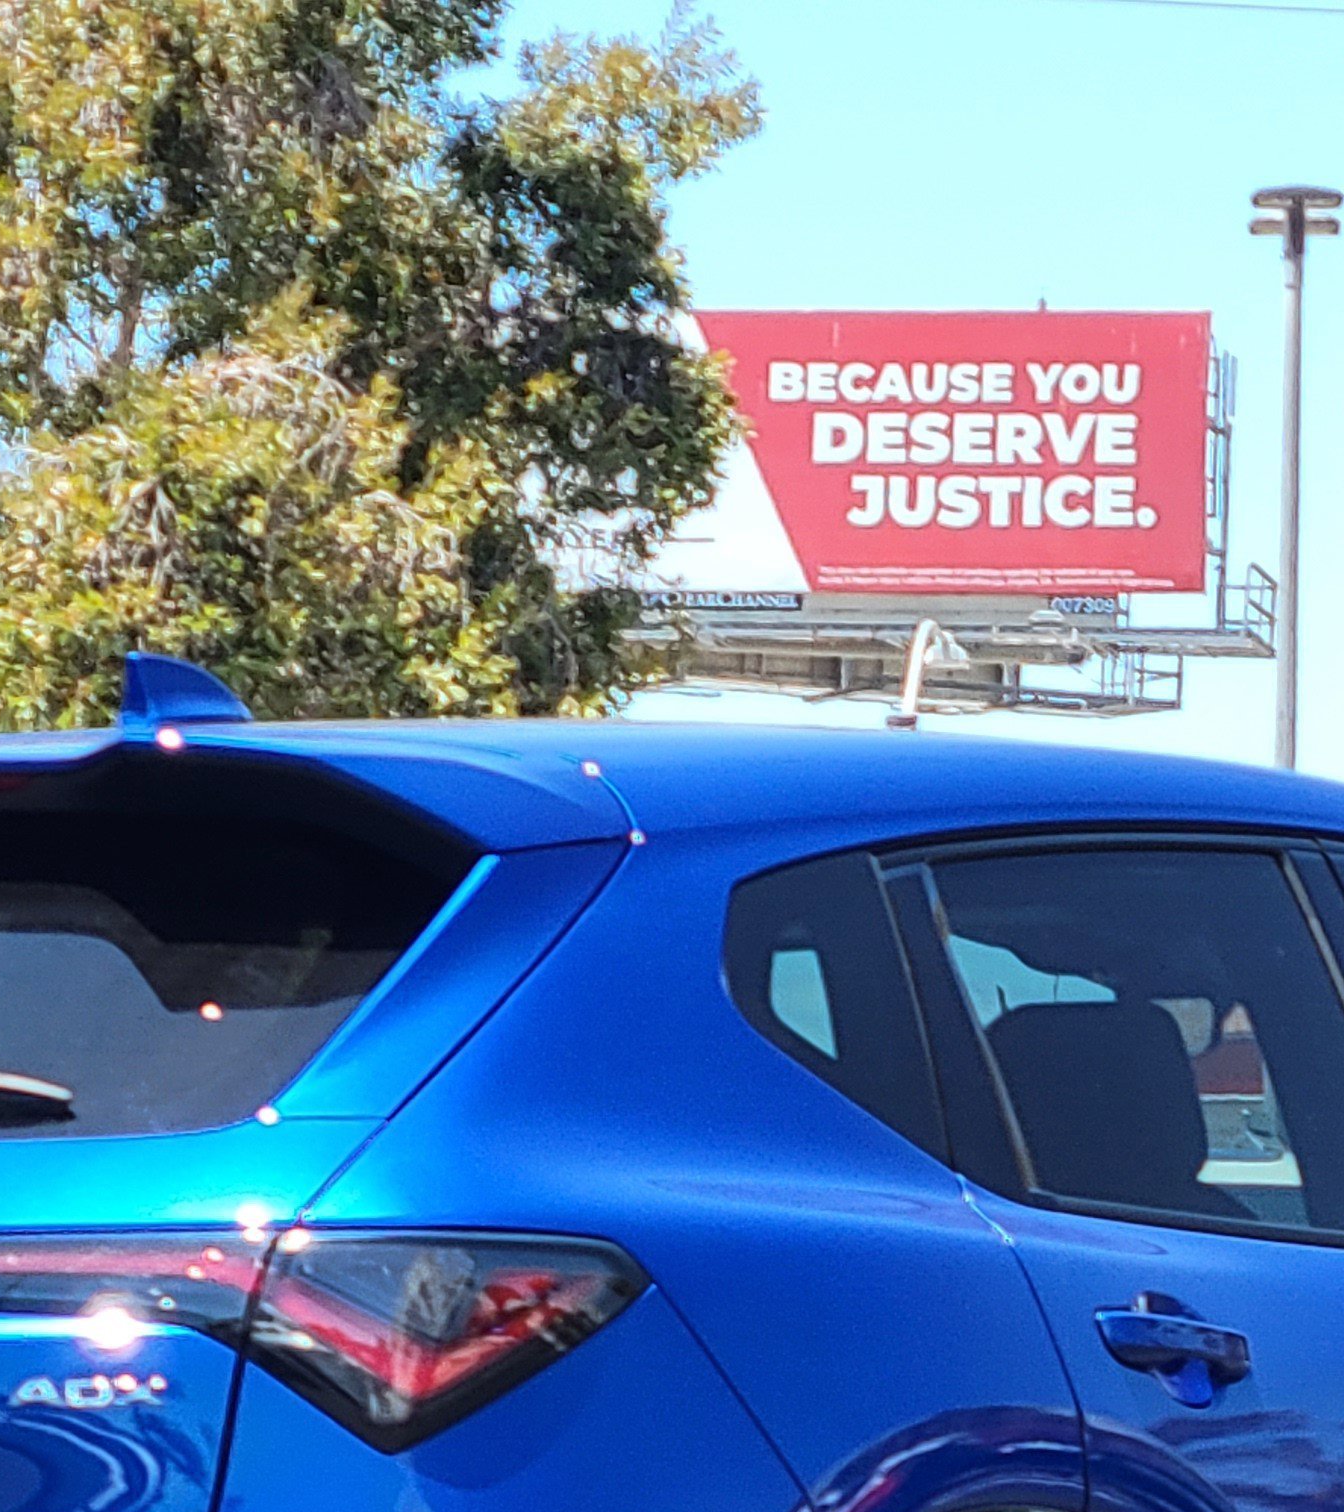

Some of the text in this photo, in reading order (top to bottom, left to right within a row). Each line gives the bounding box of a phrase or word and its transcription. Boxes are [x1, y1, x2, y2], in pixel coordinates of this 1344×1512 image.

[768, 362, 1140, 404] BECAUSE YOU
[812, 411, 1138, 464] DESERVE
[846, 474, 1157, 528] JUSTICE.
